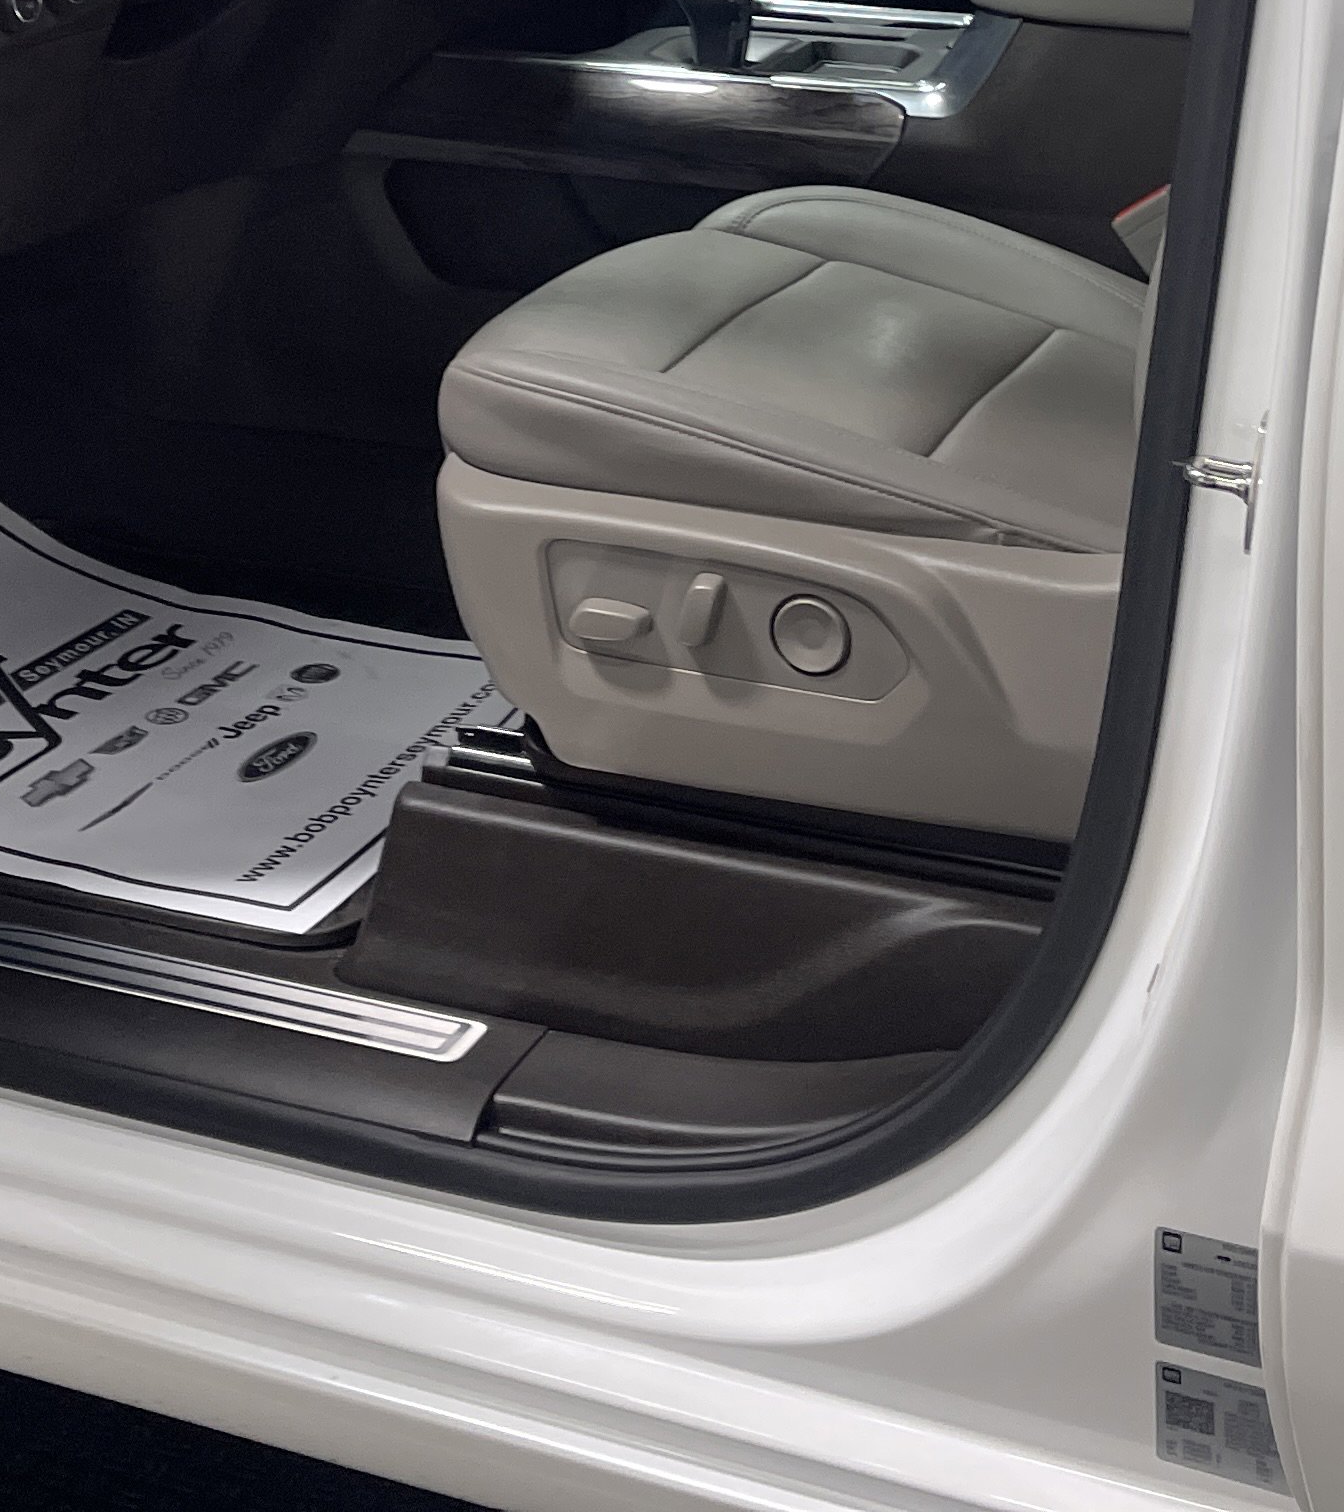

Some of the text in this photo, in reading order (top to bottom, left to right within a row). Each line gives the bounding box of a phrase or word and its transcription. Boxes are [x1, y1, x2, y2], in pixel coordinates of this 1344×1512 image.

[110, 611, 142, 634] IN
[175, 660, 261, 706] GMC
[218, 703, 282, 739] Jeep
[235, 679, 496, 883] www.bobpoynterseymour.co
